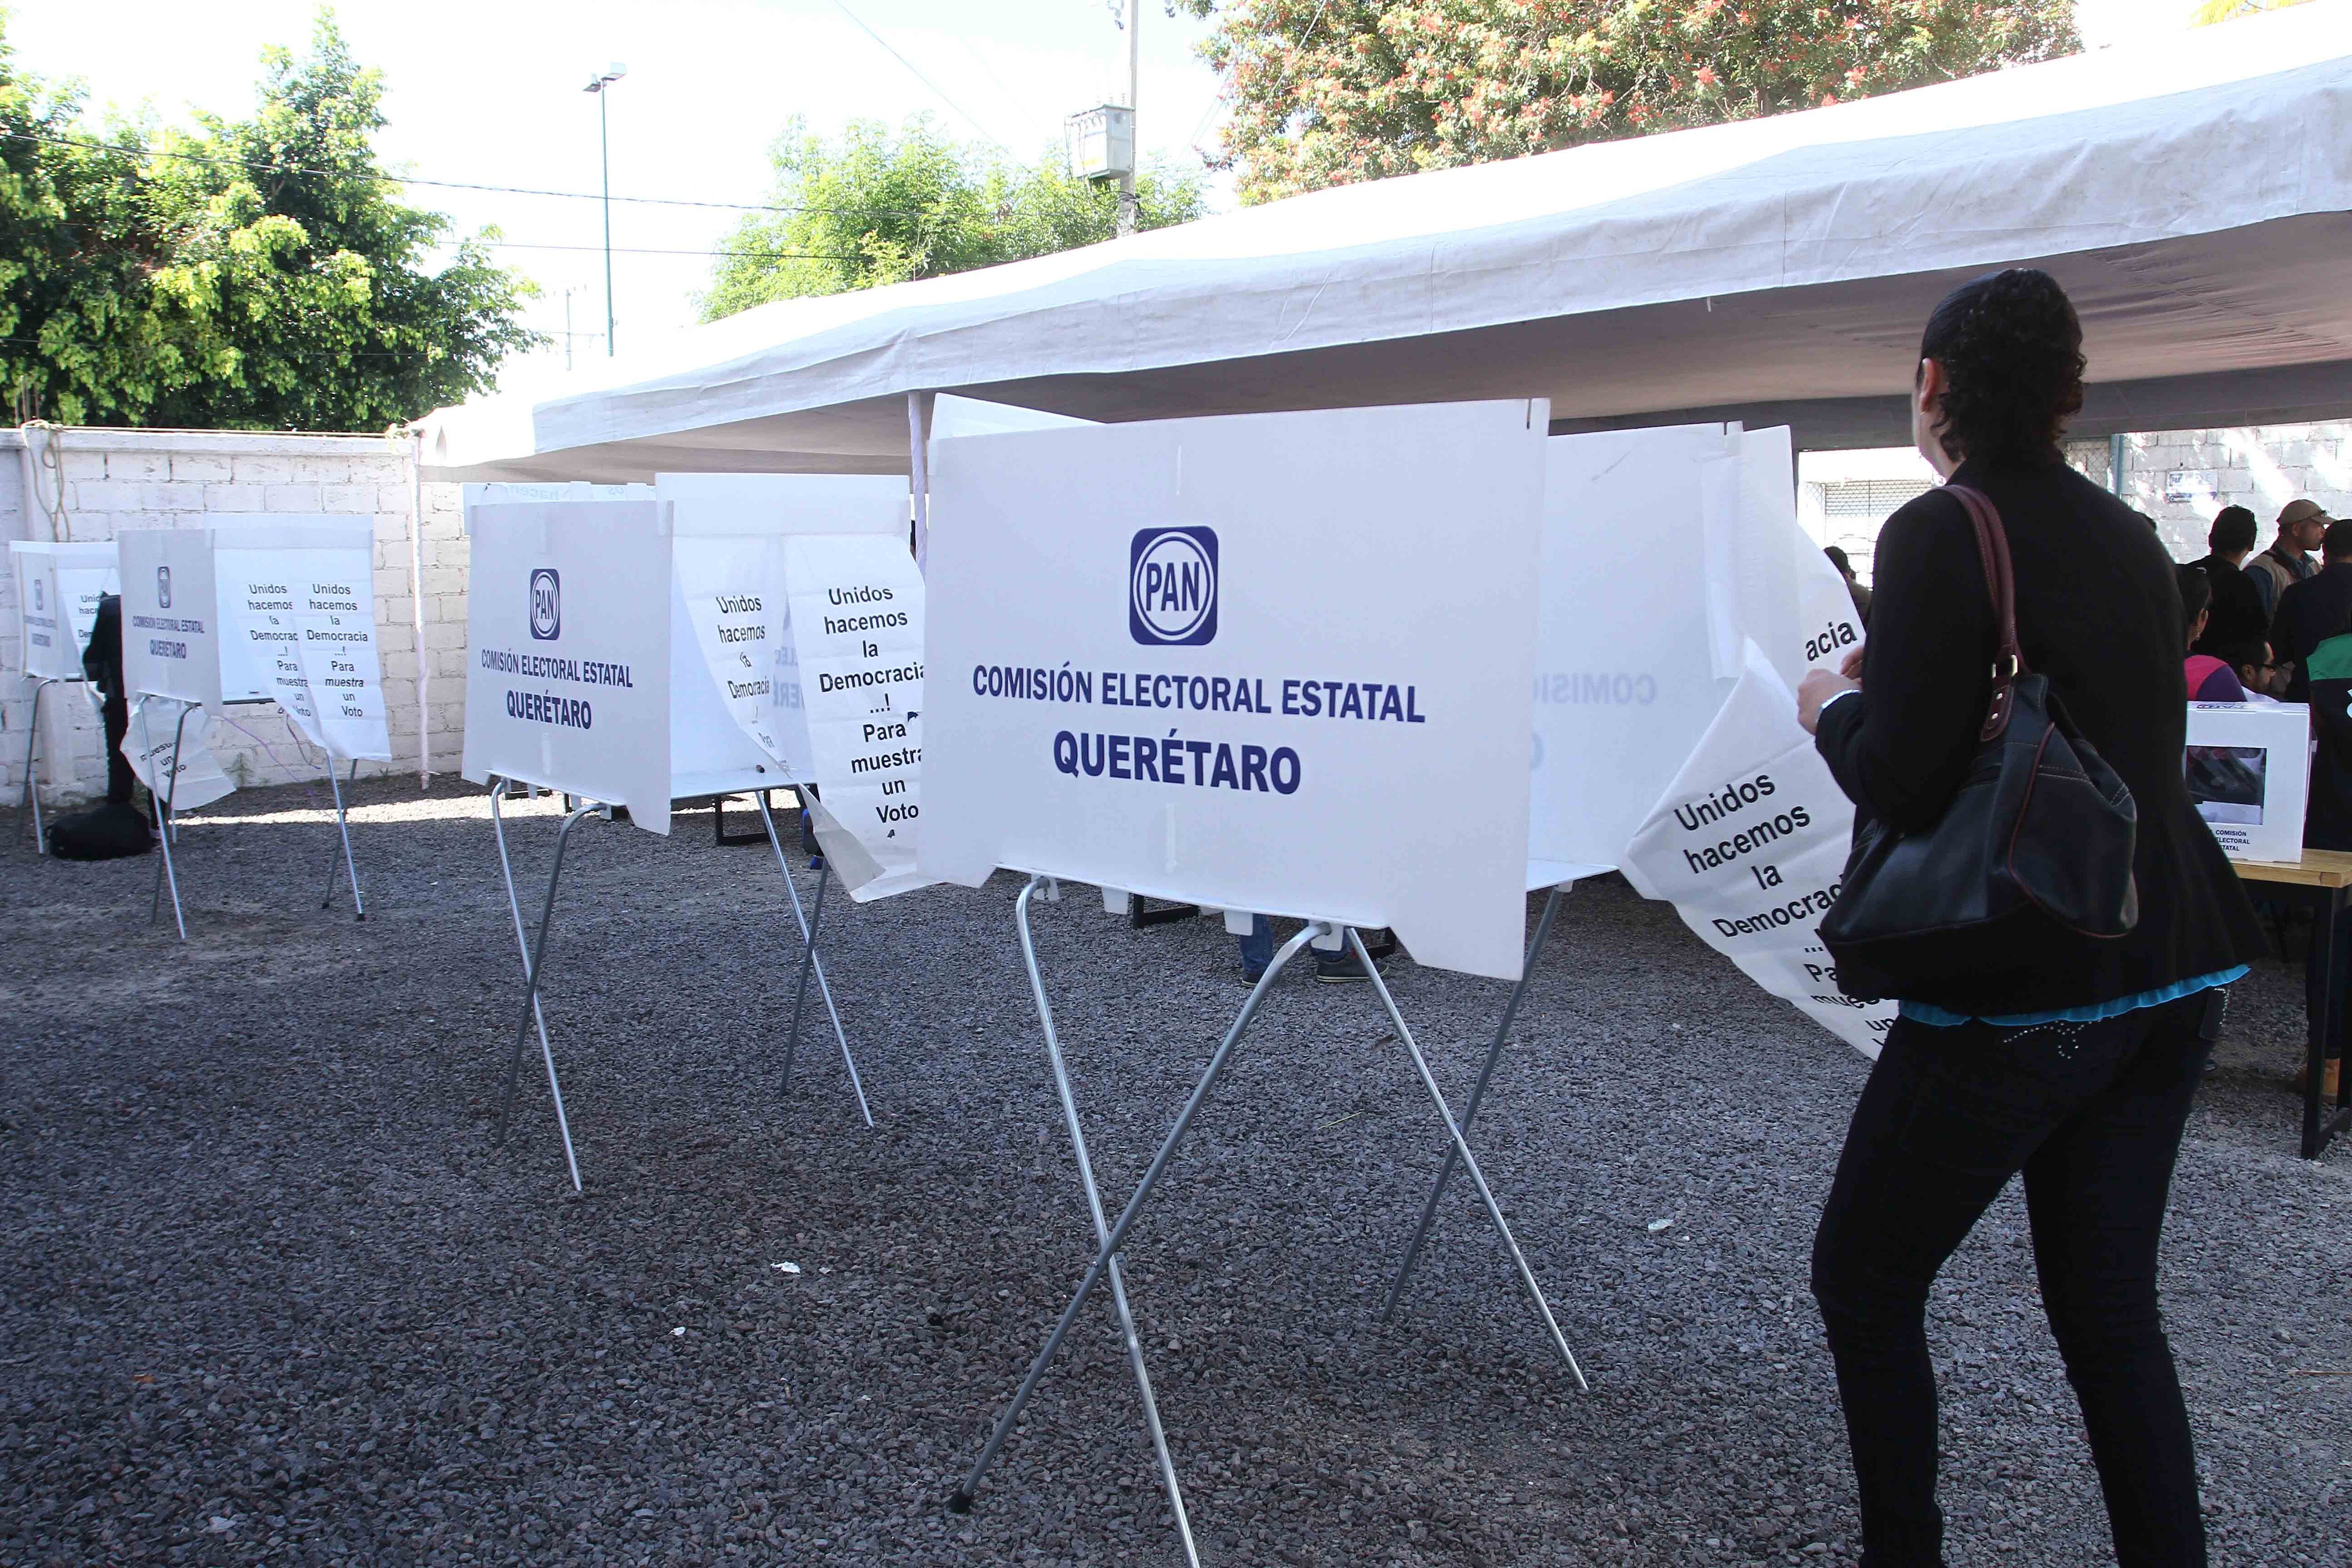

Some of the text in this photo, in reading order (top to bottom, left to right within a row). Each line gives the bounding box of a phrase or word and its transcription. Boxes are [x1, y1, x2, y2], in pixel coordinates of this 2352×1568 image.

[248, 584, 287, 594] Unidos
[312, 583, 351, 595] Unidos
[828, 586, 893, 605] Unidos
[1146, 562, 1200, 612] PAN
[247, 599, 293, 610] hacemos
[309, 599, 357, 611] hacemos
[535, 589, 554, 619] PAN
[716, 595, 762, 613] Unidos
[181, 620, 205, 633] ESTATAL
[330, 615, 340, 625] la
[824, 612, 907, 634] hacemos
[250, 630, 298, 640] Democrac
[306, 629, 368, 642] Democracia
[718, 624, 765, 643] hacemos
[863, 640, 878, 658] la
[277, 661, 298, 671] Para
[331, 661, 355, 671] Para
[482, 648, 633, 687] COMISIÓN ELECTORAL ESTATAL
[325, 677, 364, 687] muestra
[973, 661, 1426, 723] COMISIÓN ELECTORAL ESTATAL
[341, 706, 363, 717] Voto
[507, 689, 591, 729] QUERÉTARO
[870, 693, 890, 713] ...!
[863, 724, 906, 742] Para
[160, 756, 174, 766] un
[1054, 728, 1301, 795] QUERÉTARO
[162, 764, 186, 778] Vto
[882, 780, 906, 795] un
[1674, 774, 1775, 831] Unidos
[875, 803, 919, 823] Voto
[1684, 806, 1811, 874] hacemos
[1751, 865, 1783, 890] la
[1712, 874, 1843, 937] Democrac
[1804, 963, 1837, 982] Pa
